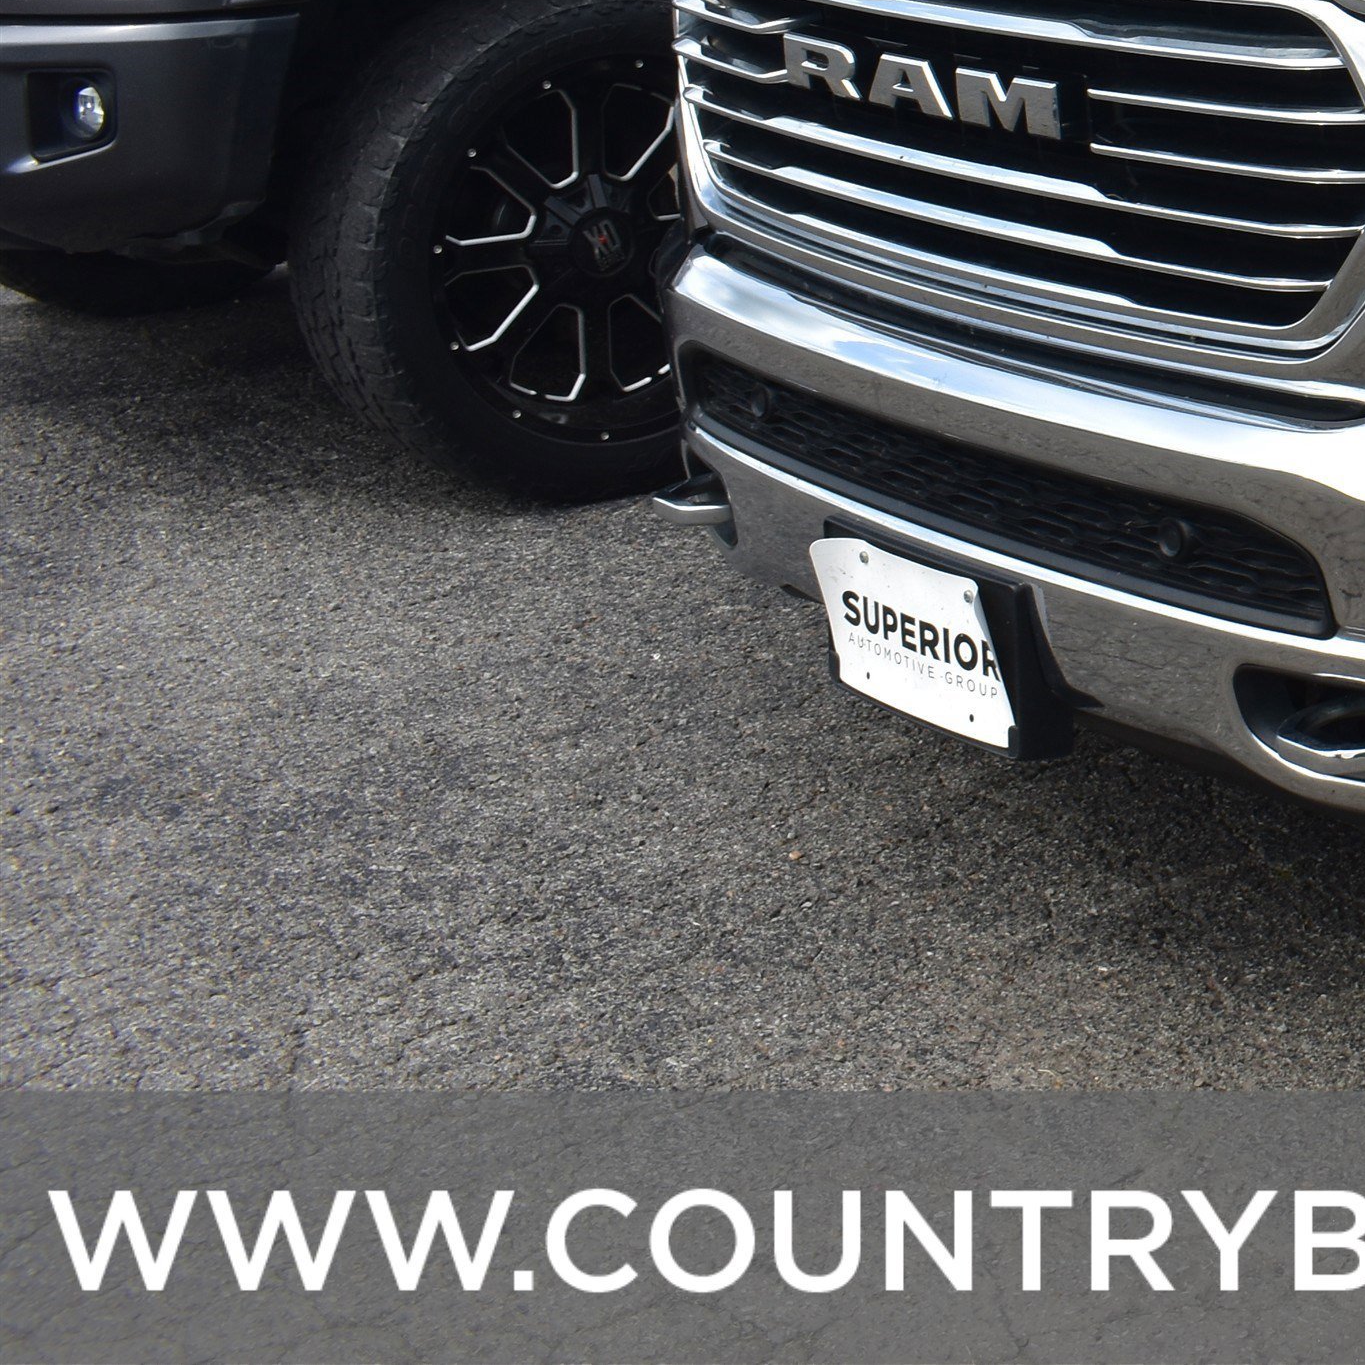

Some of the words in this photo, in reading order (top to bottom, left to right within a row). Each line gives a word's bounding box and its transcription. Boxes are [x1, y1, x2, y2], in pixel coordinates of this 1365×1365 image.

[783, 32, 1062, 140] RAM
[842, 590, 1002, 682] SUPERIOR
[848, 632, 935, 680] AUTOMOTIVE
[944, 671, 998, 699] GROUP
